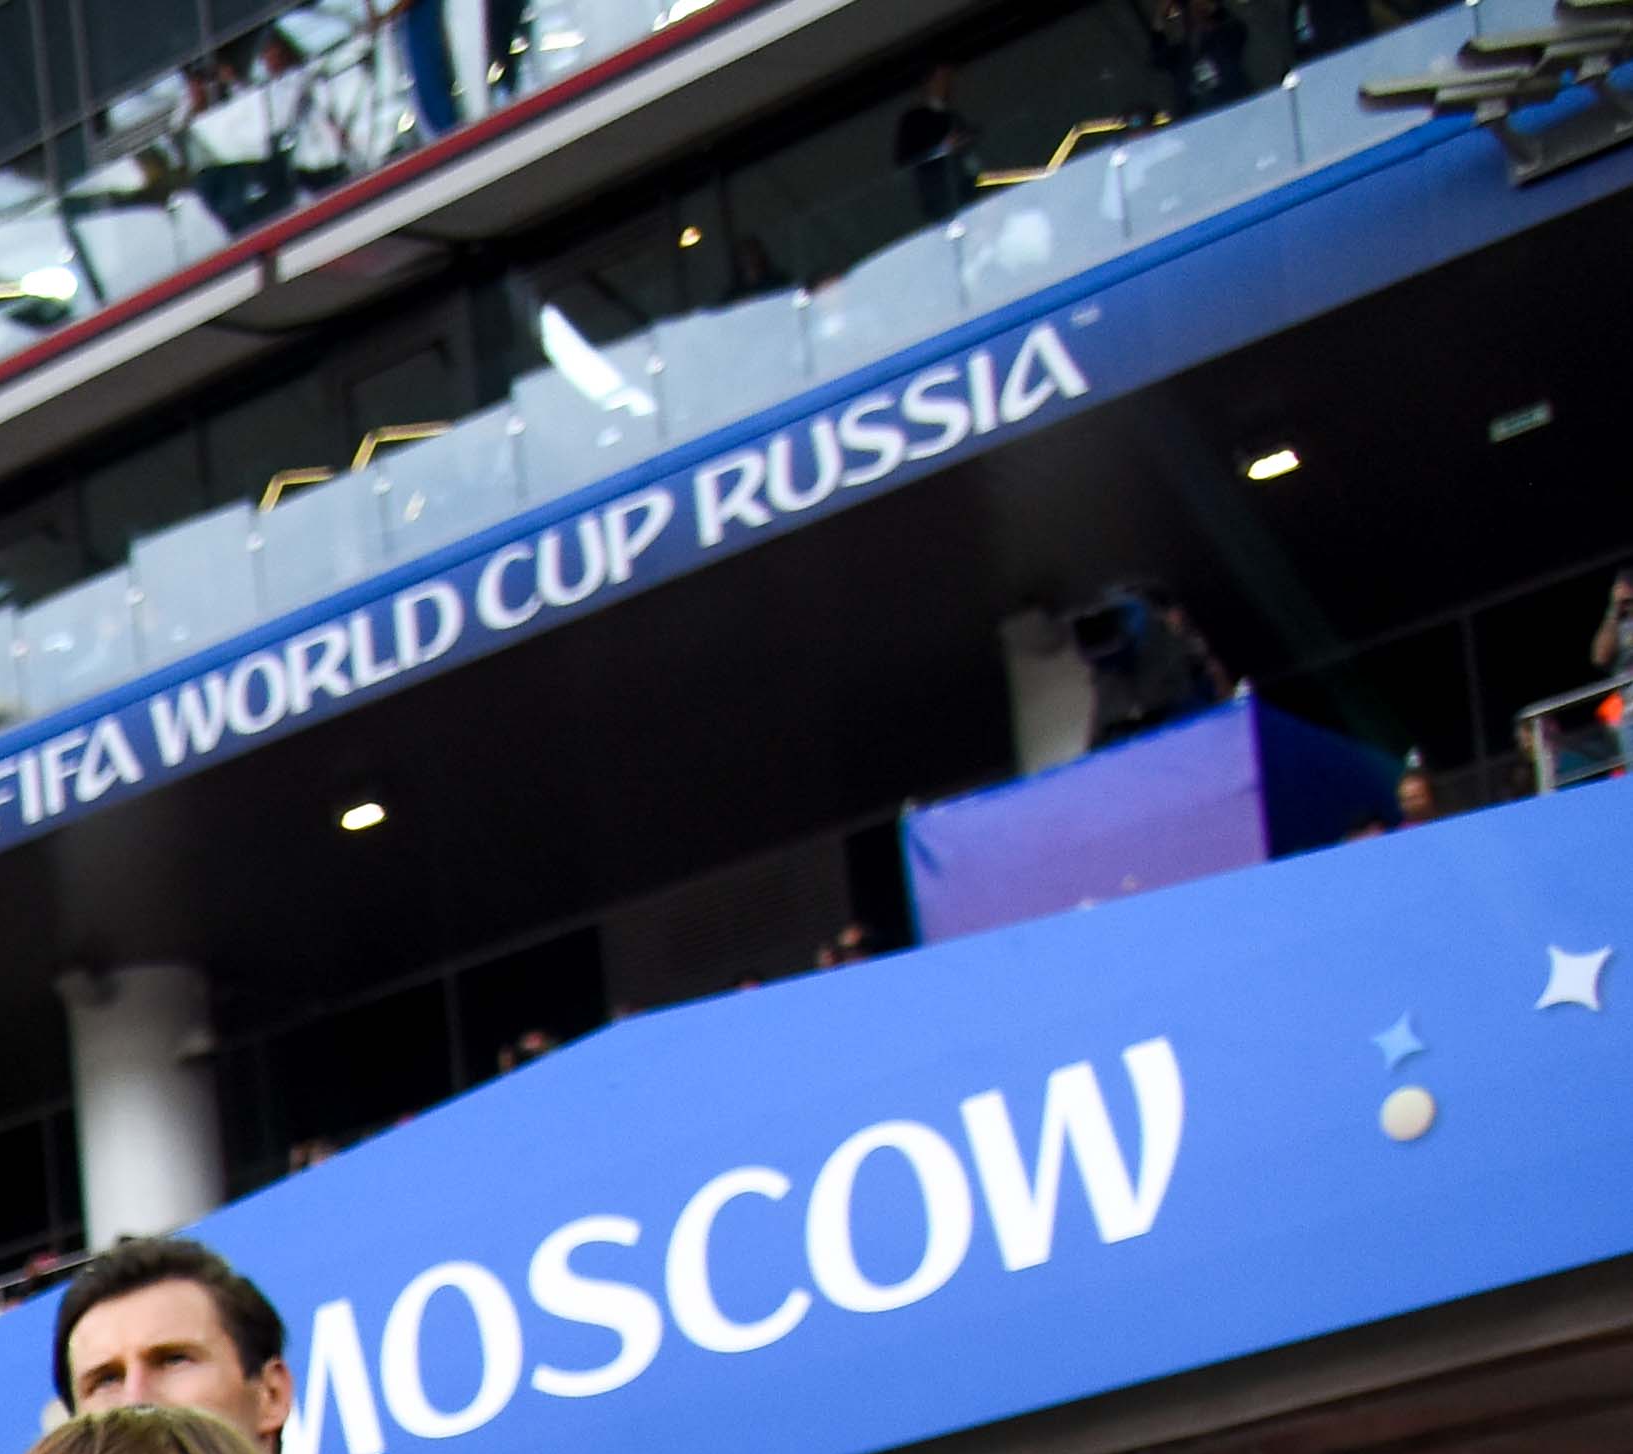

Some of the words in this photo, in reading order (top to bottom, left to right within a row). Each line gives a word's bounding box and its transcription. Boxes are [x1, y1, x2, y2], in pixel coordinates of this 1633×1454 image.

[148, 582, 463, 769] WORLD
[475, 488, 675, 630] CUP
[693, 323, 1090, 548] RUSSIA
